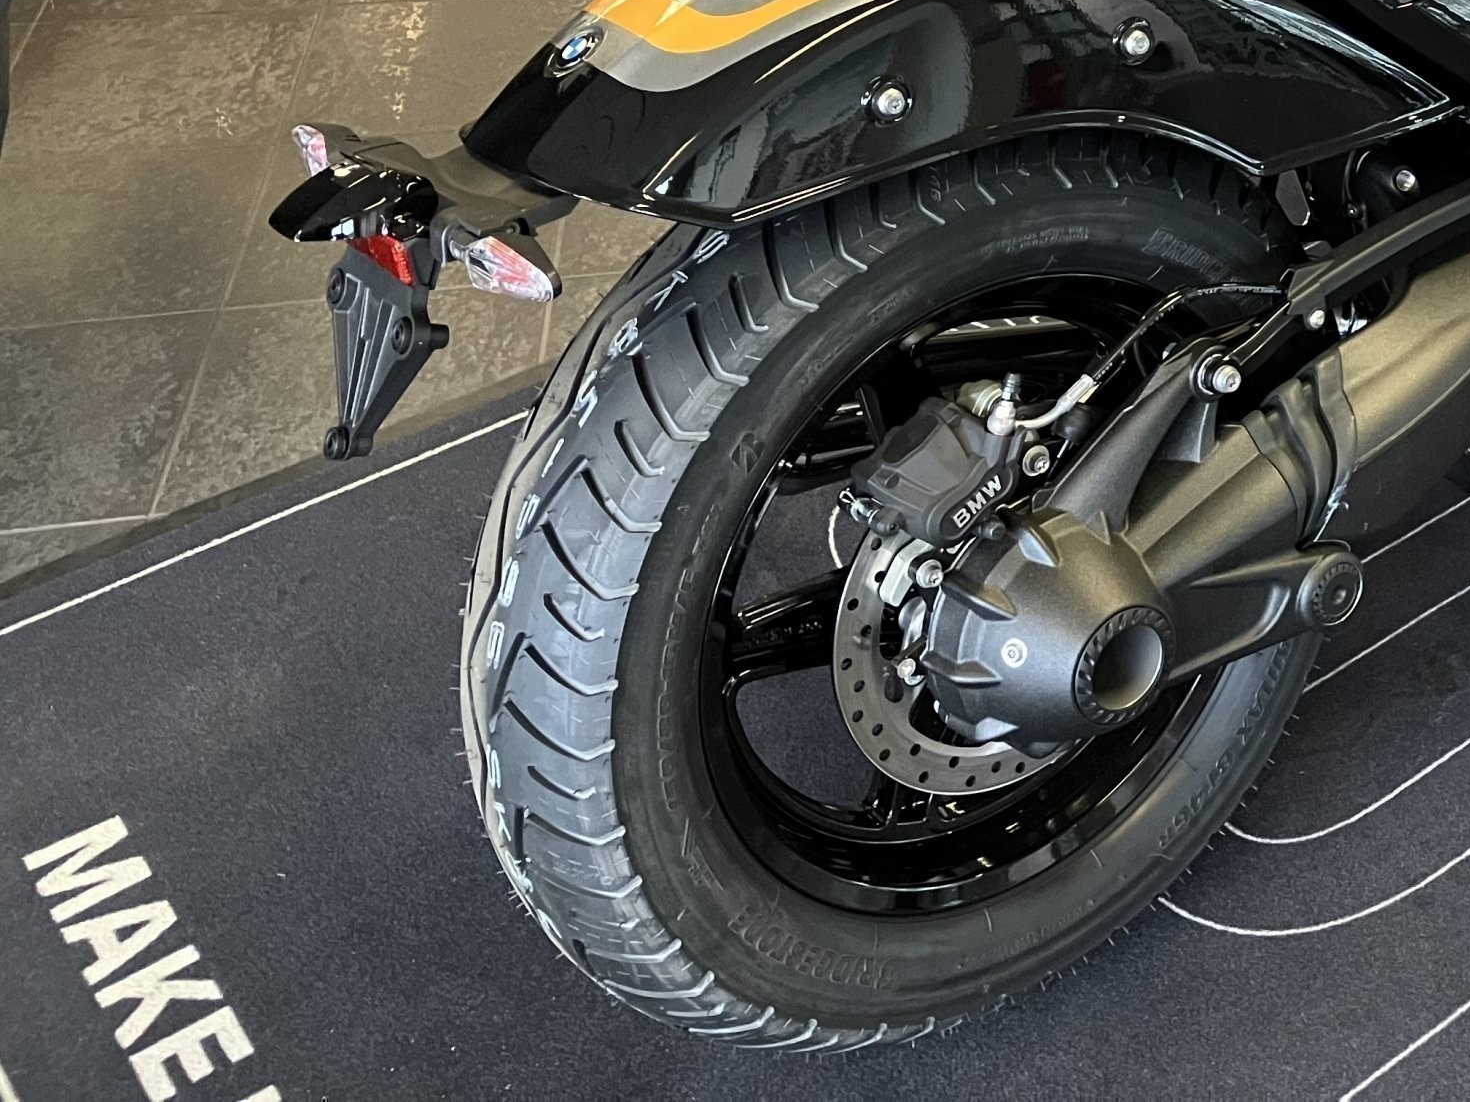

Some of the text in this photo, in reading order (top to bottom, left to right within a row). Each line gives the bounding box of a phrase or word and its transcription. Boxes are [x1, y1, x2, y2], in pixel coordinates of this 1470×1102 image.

[952, 474, 1002, 529] BMW
[1232, 640, 1294, 747] ATTLAX
[22, 815, 255, 1102] MAKE
